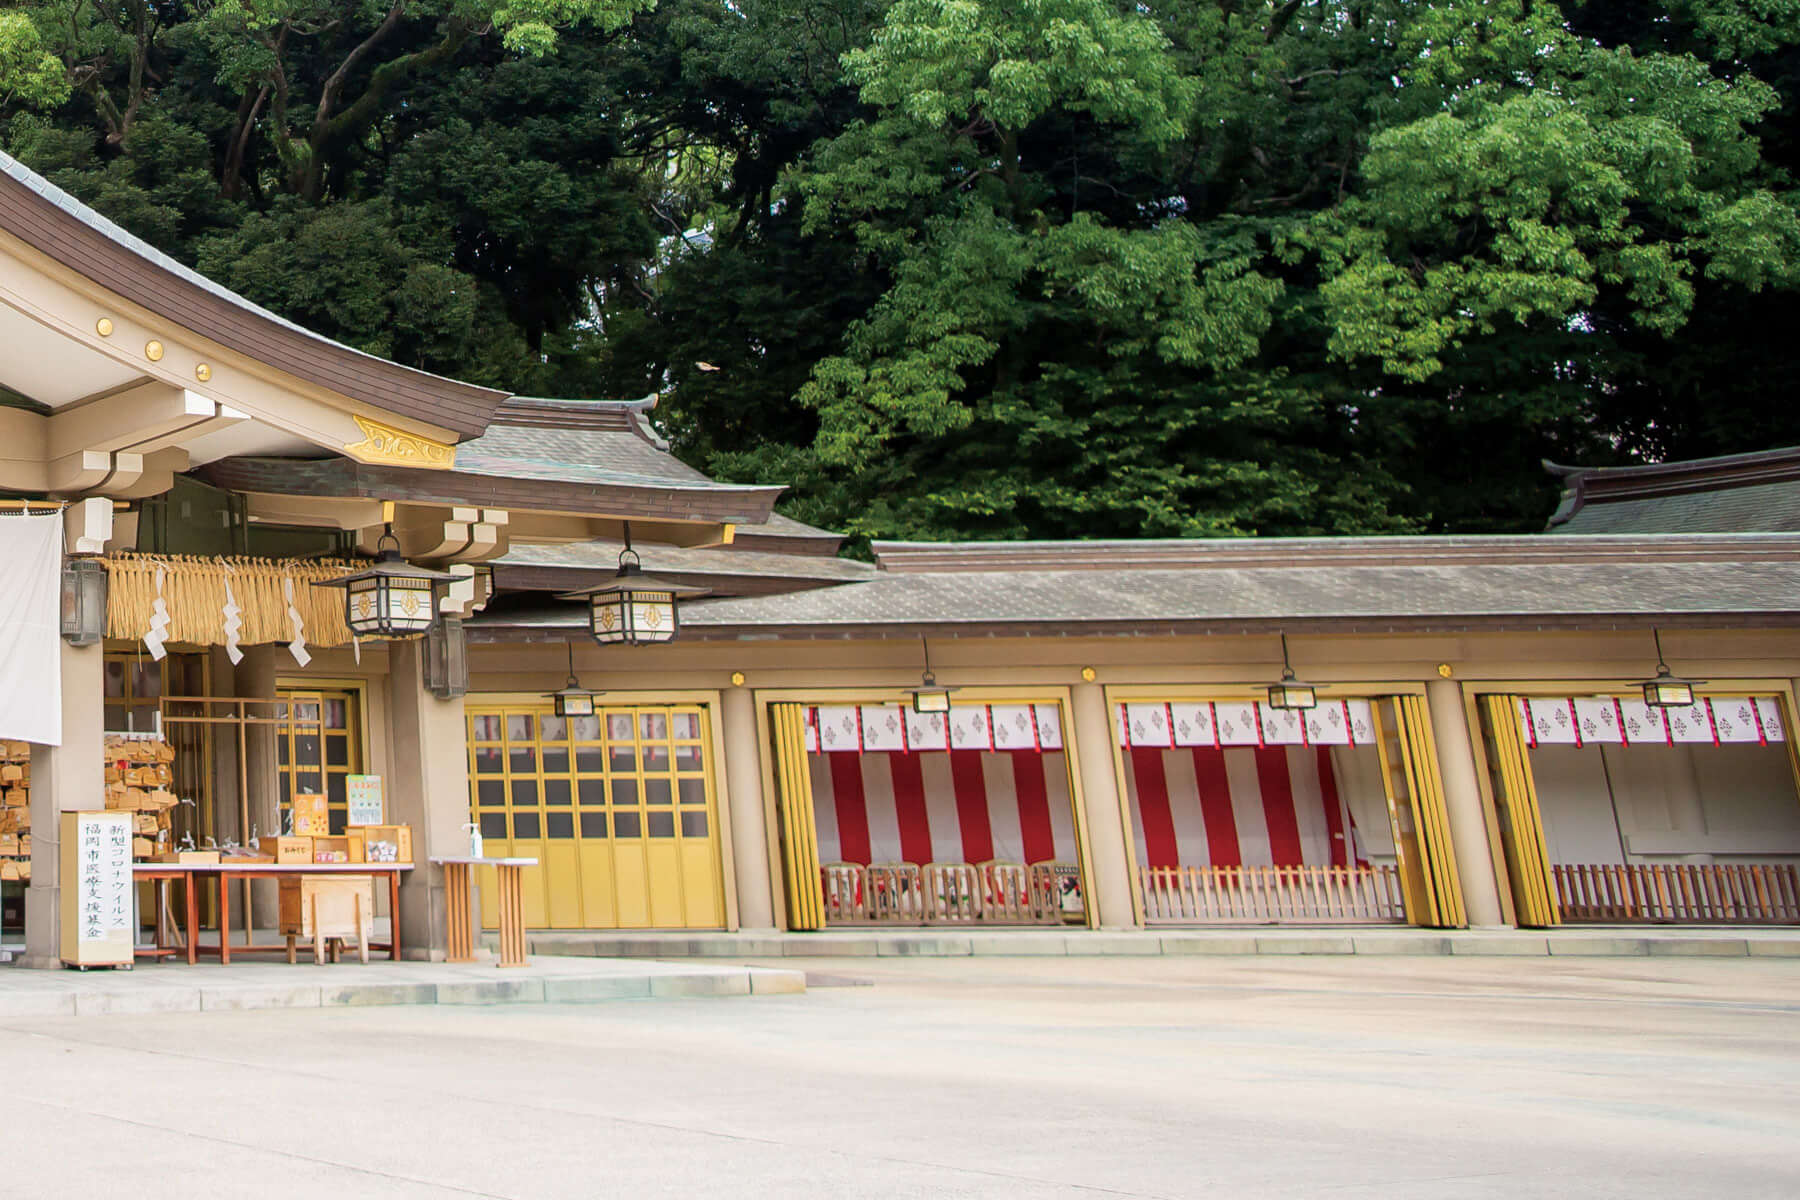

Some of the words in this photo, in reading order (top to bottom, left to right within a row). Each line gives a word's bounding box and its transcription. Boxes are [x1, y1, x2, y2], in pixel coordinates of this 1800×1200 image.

[110, 824, 126, 926] 新型コロナウイルス
